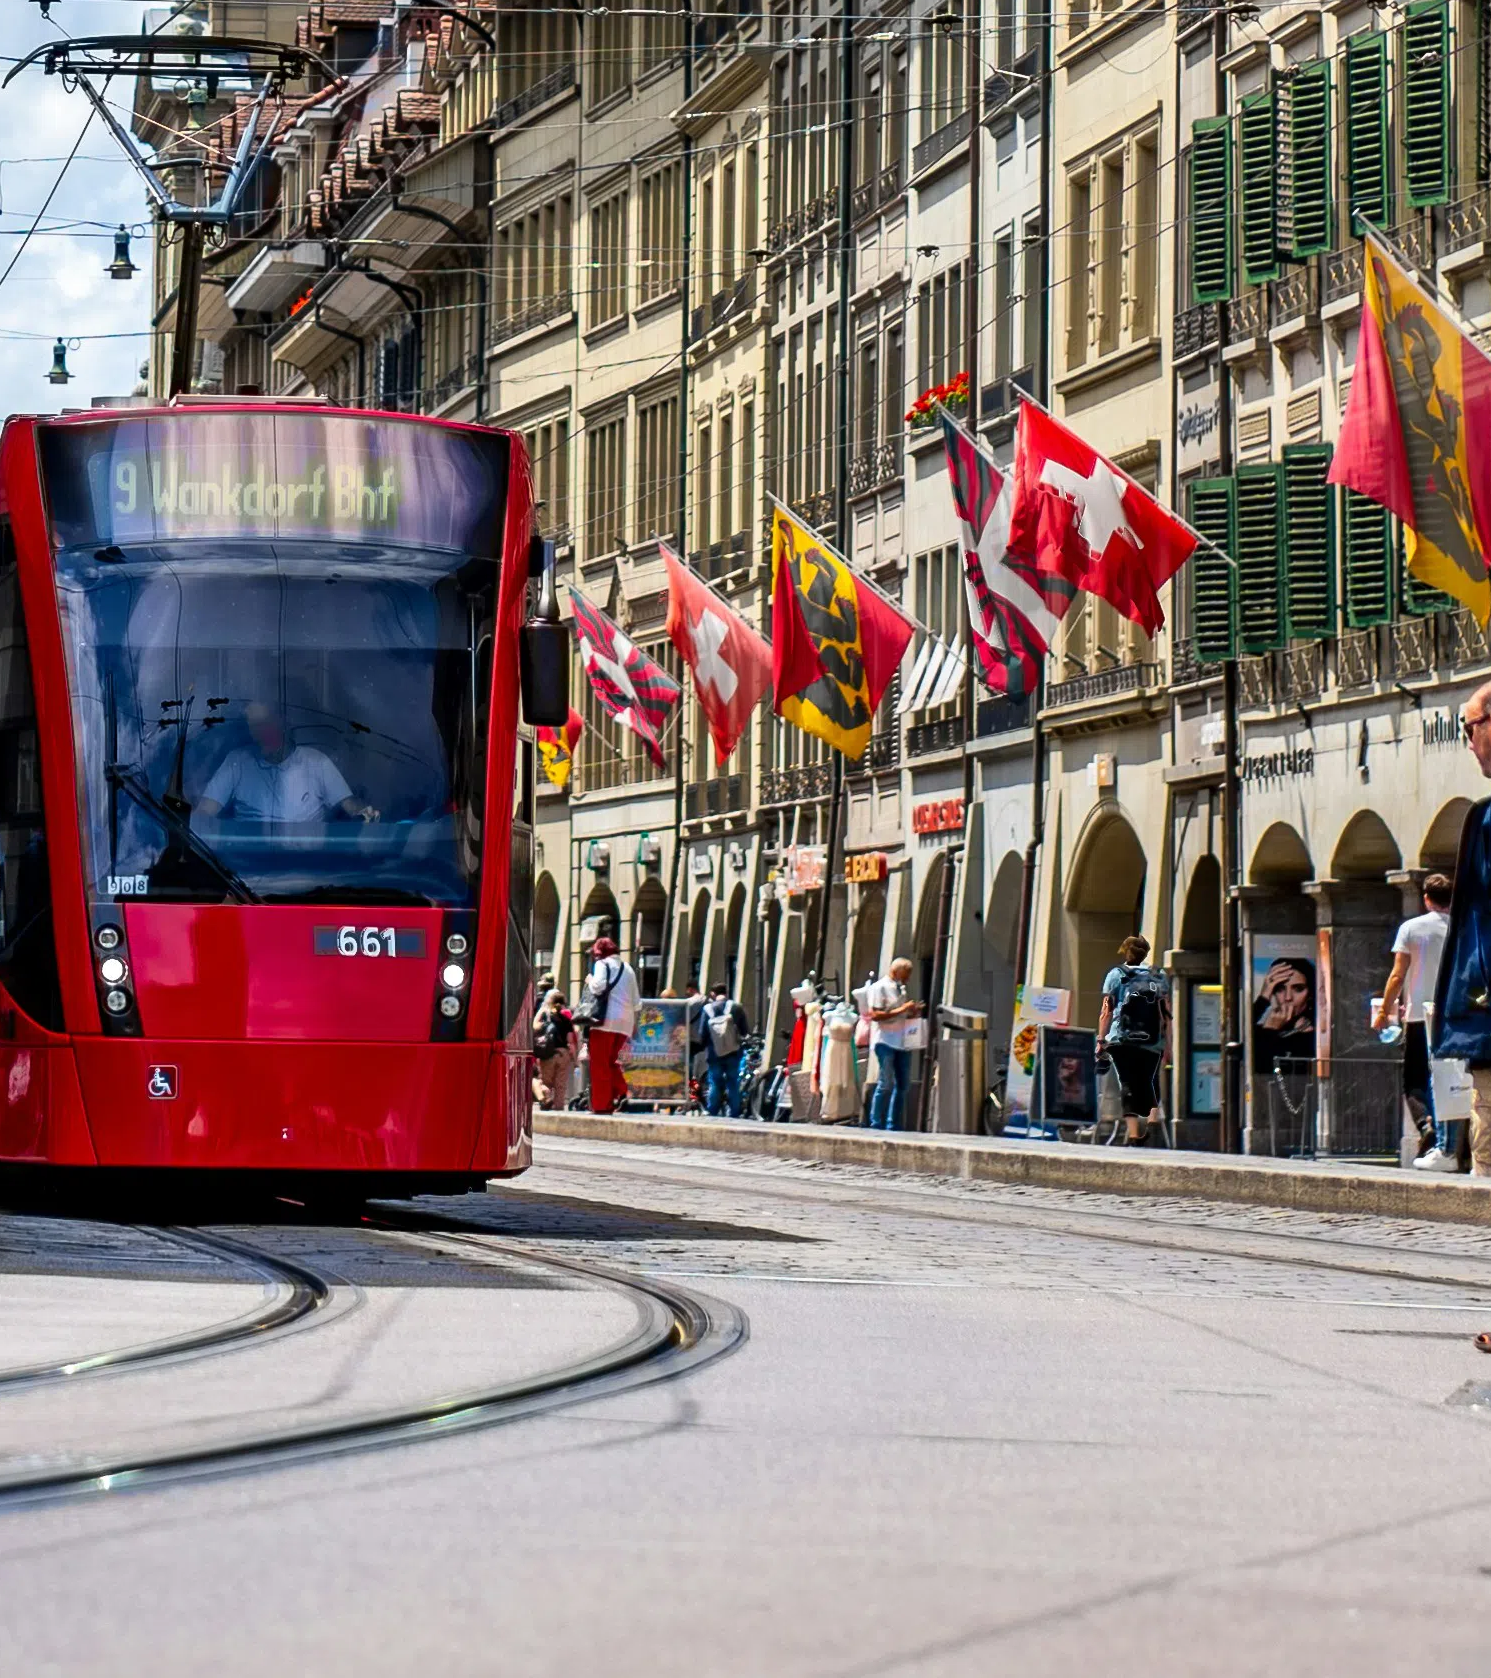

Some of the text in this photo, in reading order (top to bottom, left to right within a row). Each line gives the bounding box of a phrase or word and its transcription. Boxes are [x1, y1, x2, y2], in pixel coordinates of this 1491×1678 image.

[116, 461, 396, 521] 9 Wankdorf Bhf
[110, 874, 146, 893] 908
[336, 926, 397, 958] 661
